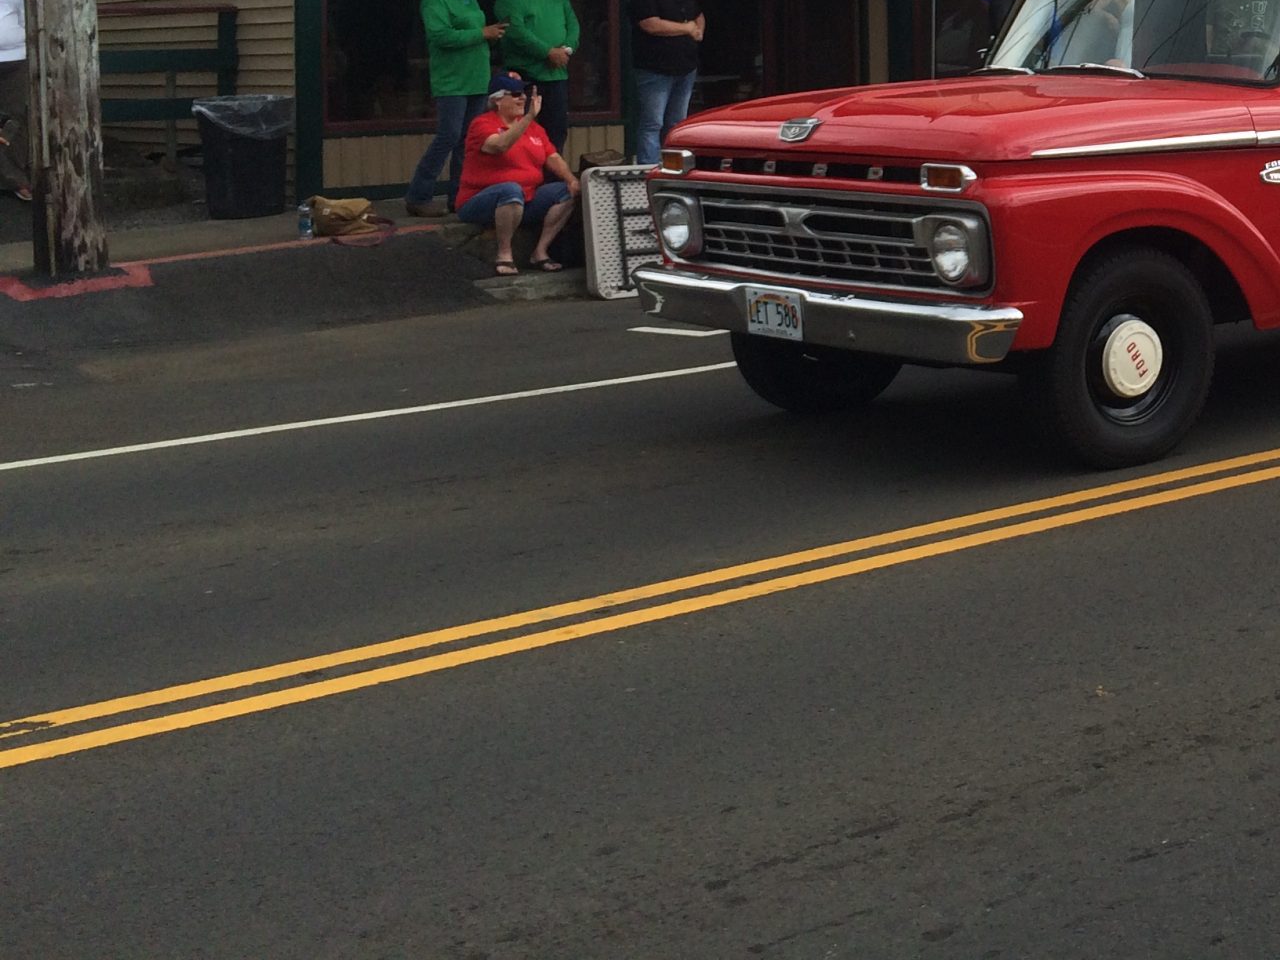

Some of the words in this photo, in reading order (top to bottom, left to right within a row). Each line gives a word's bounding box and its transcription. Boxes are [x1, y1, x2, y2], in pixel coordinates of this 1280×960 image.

[720, 158, 883, 179] FORD
[749, 299, 769, 325] LET
[1126, 342, 1148, 378] FORD
